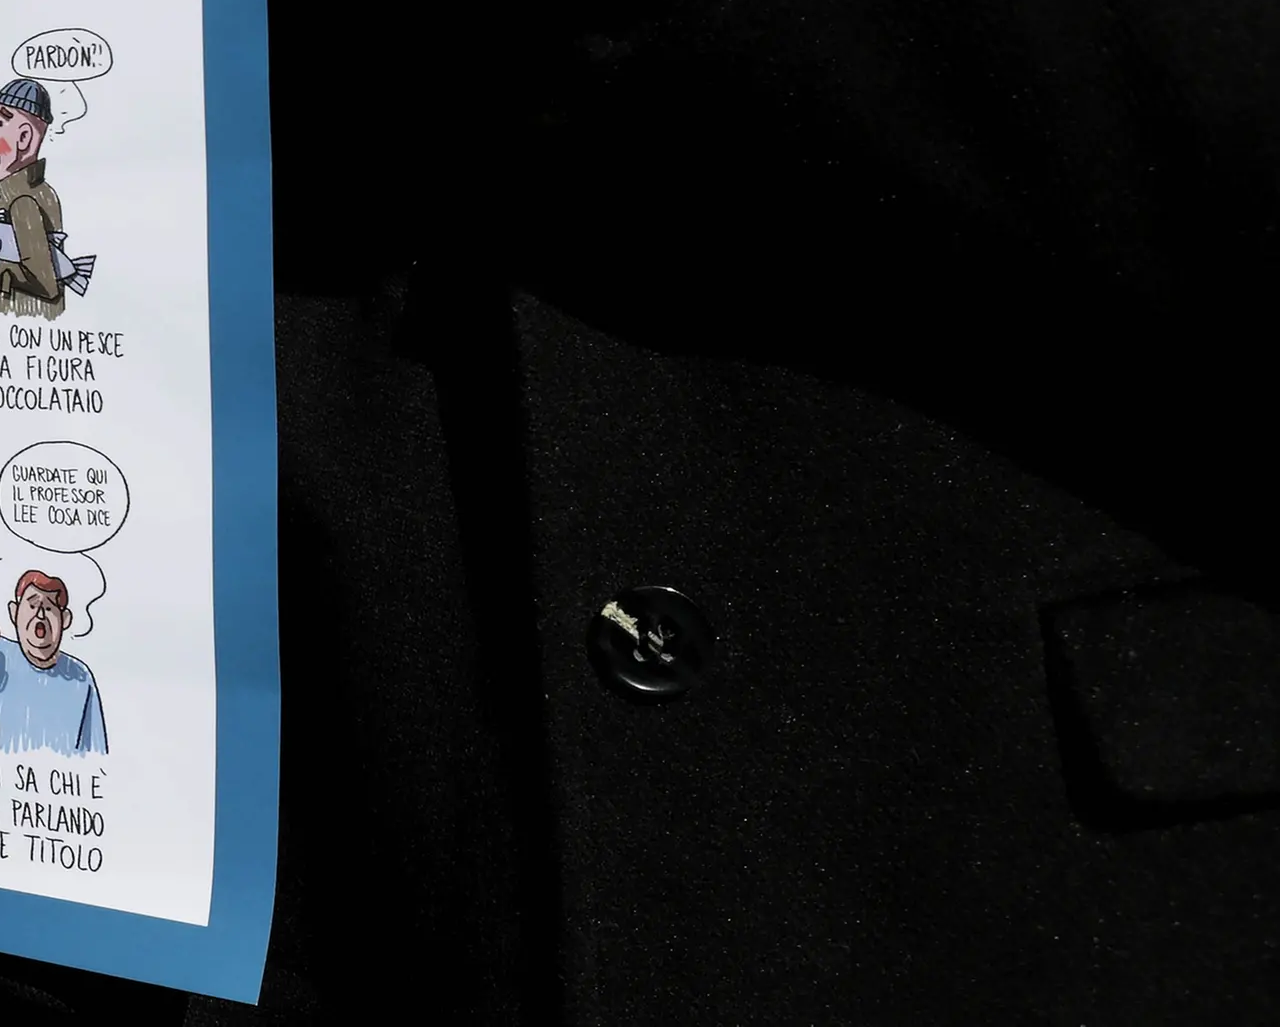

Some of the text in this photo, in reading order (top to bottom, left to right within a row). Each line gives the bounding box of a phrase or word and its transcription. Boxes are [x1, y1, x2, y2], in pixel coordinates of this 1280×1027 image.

[9, 324, 42, 350] CON
[49, 328, 73, 353] UN
[78, 330, 125, 358] PESCE
[26, 354, 96, 383] FIGURA
[12, 464, 108, 486] GUARDATE QUI
[13, 485, 106, 505] IL PROFESSOR
[13, 503, 111, 527] LEE COSA DICE
[15, 764, 39, 793] SA
[50, 769, 81, 796] CHI
[11, 799, 105, 837] PARLANDO
[24, 834, 103, 872] TITOLO
